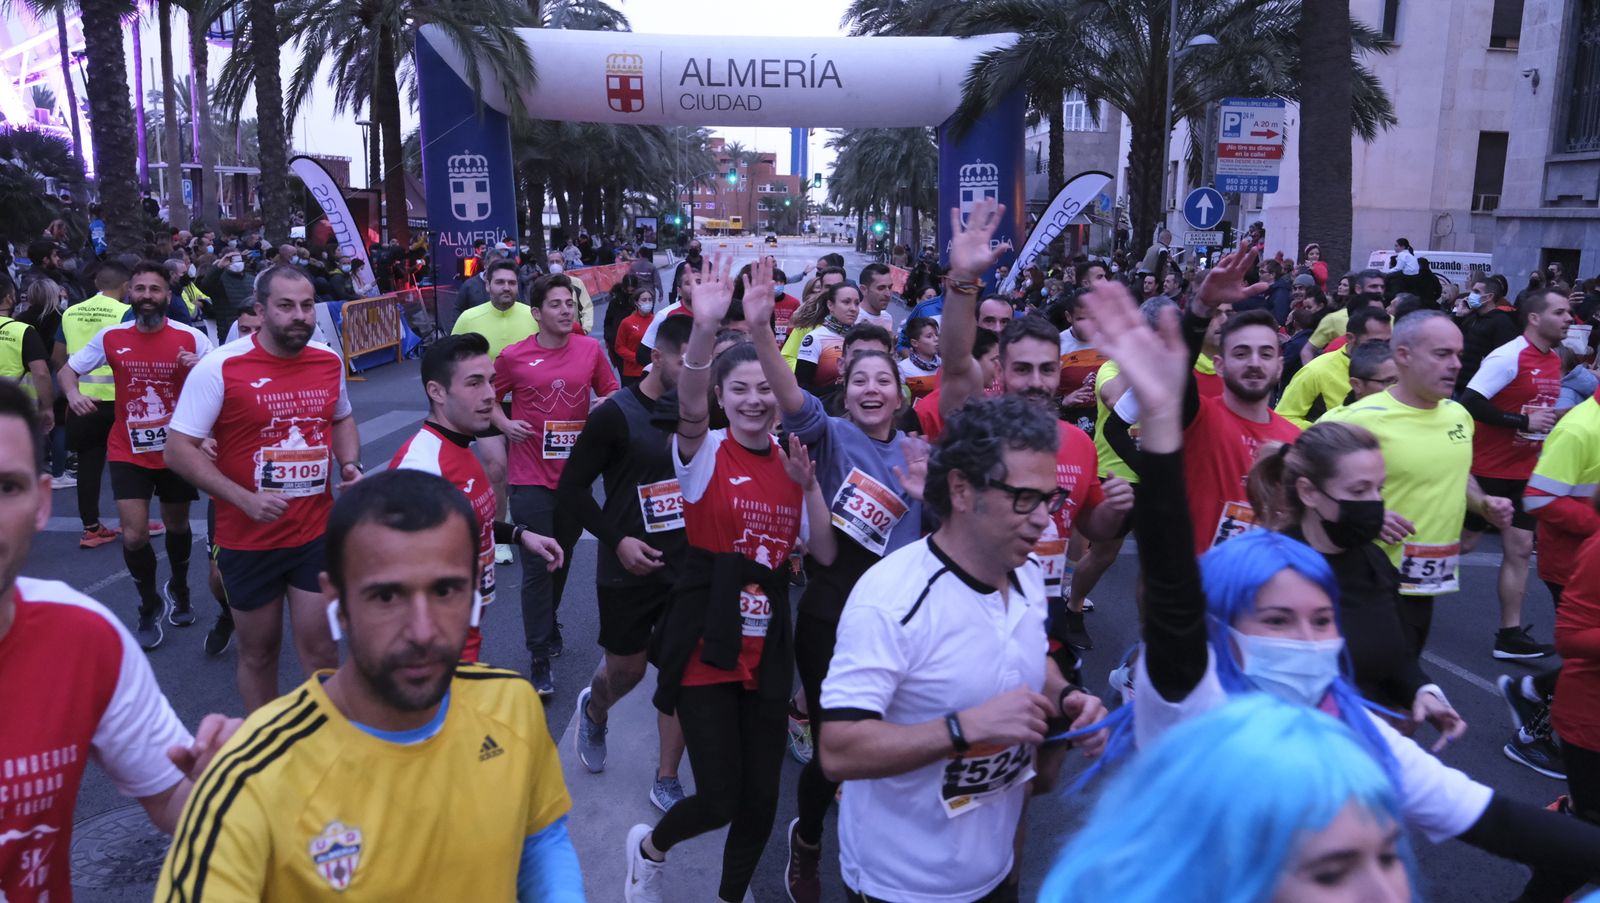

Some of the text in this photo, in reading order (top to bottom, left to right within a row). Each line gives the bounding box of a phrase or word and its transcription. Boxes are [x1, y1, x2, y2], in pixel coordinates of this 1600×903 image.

[679, 53, 843, 89] ALMERÍA
[679, 93, 762, 112] CIUDAD
[145, 427, 167, 440] 94
[275, 464, 320, 479] 3109
[849, 495, 891, 531] 3302
[1421, 559, 1447, 577] 51
[964, 743, 1031, 784] 524
